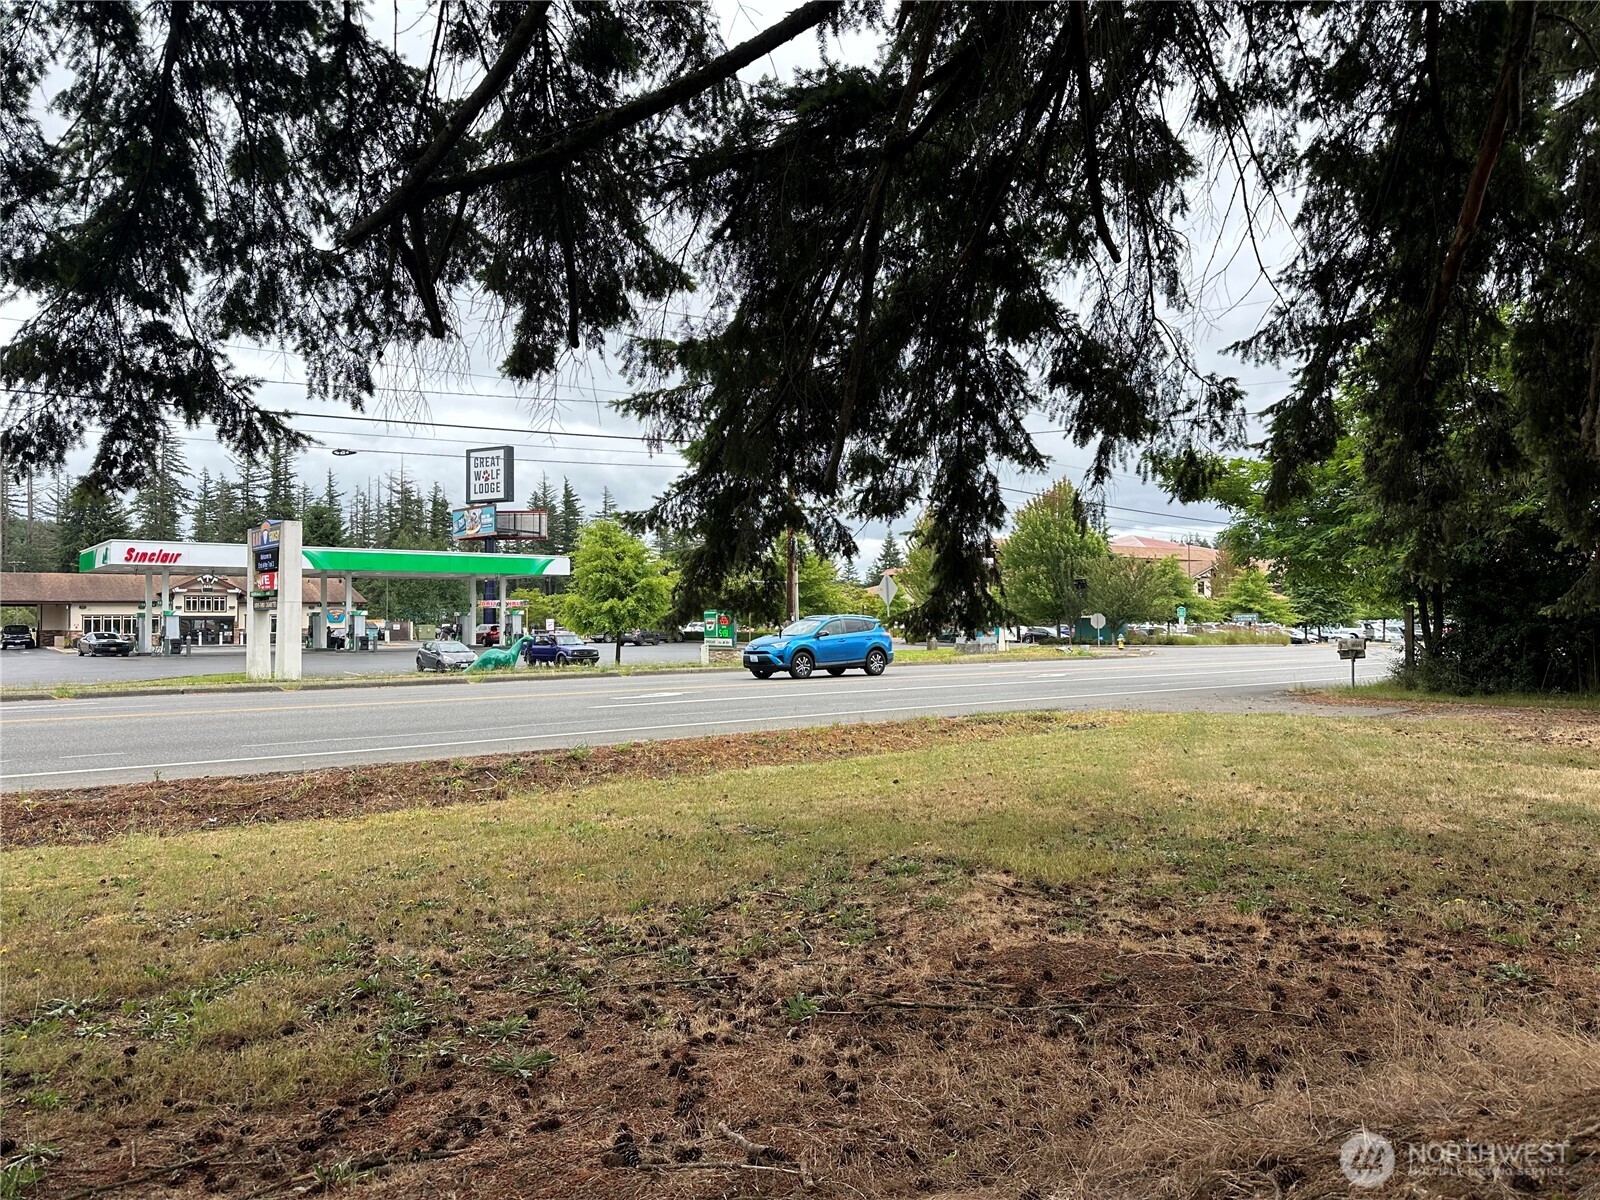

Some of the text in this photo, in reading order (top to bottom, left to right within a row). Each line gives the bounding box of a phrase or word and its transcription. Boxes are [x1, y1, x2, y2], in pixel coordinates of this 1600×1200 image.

[473, 456, 501, 468] GREAT
[473, 482, 501, 494] LODGE
[124, 547, 182, 563] Sinclair
